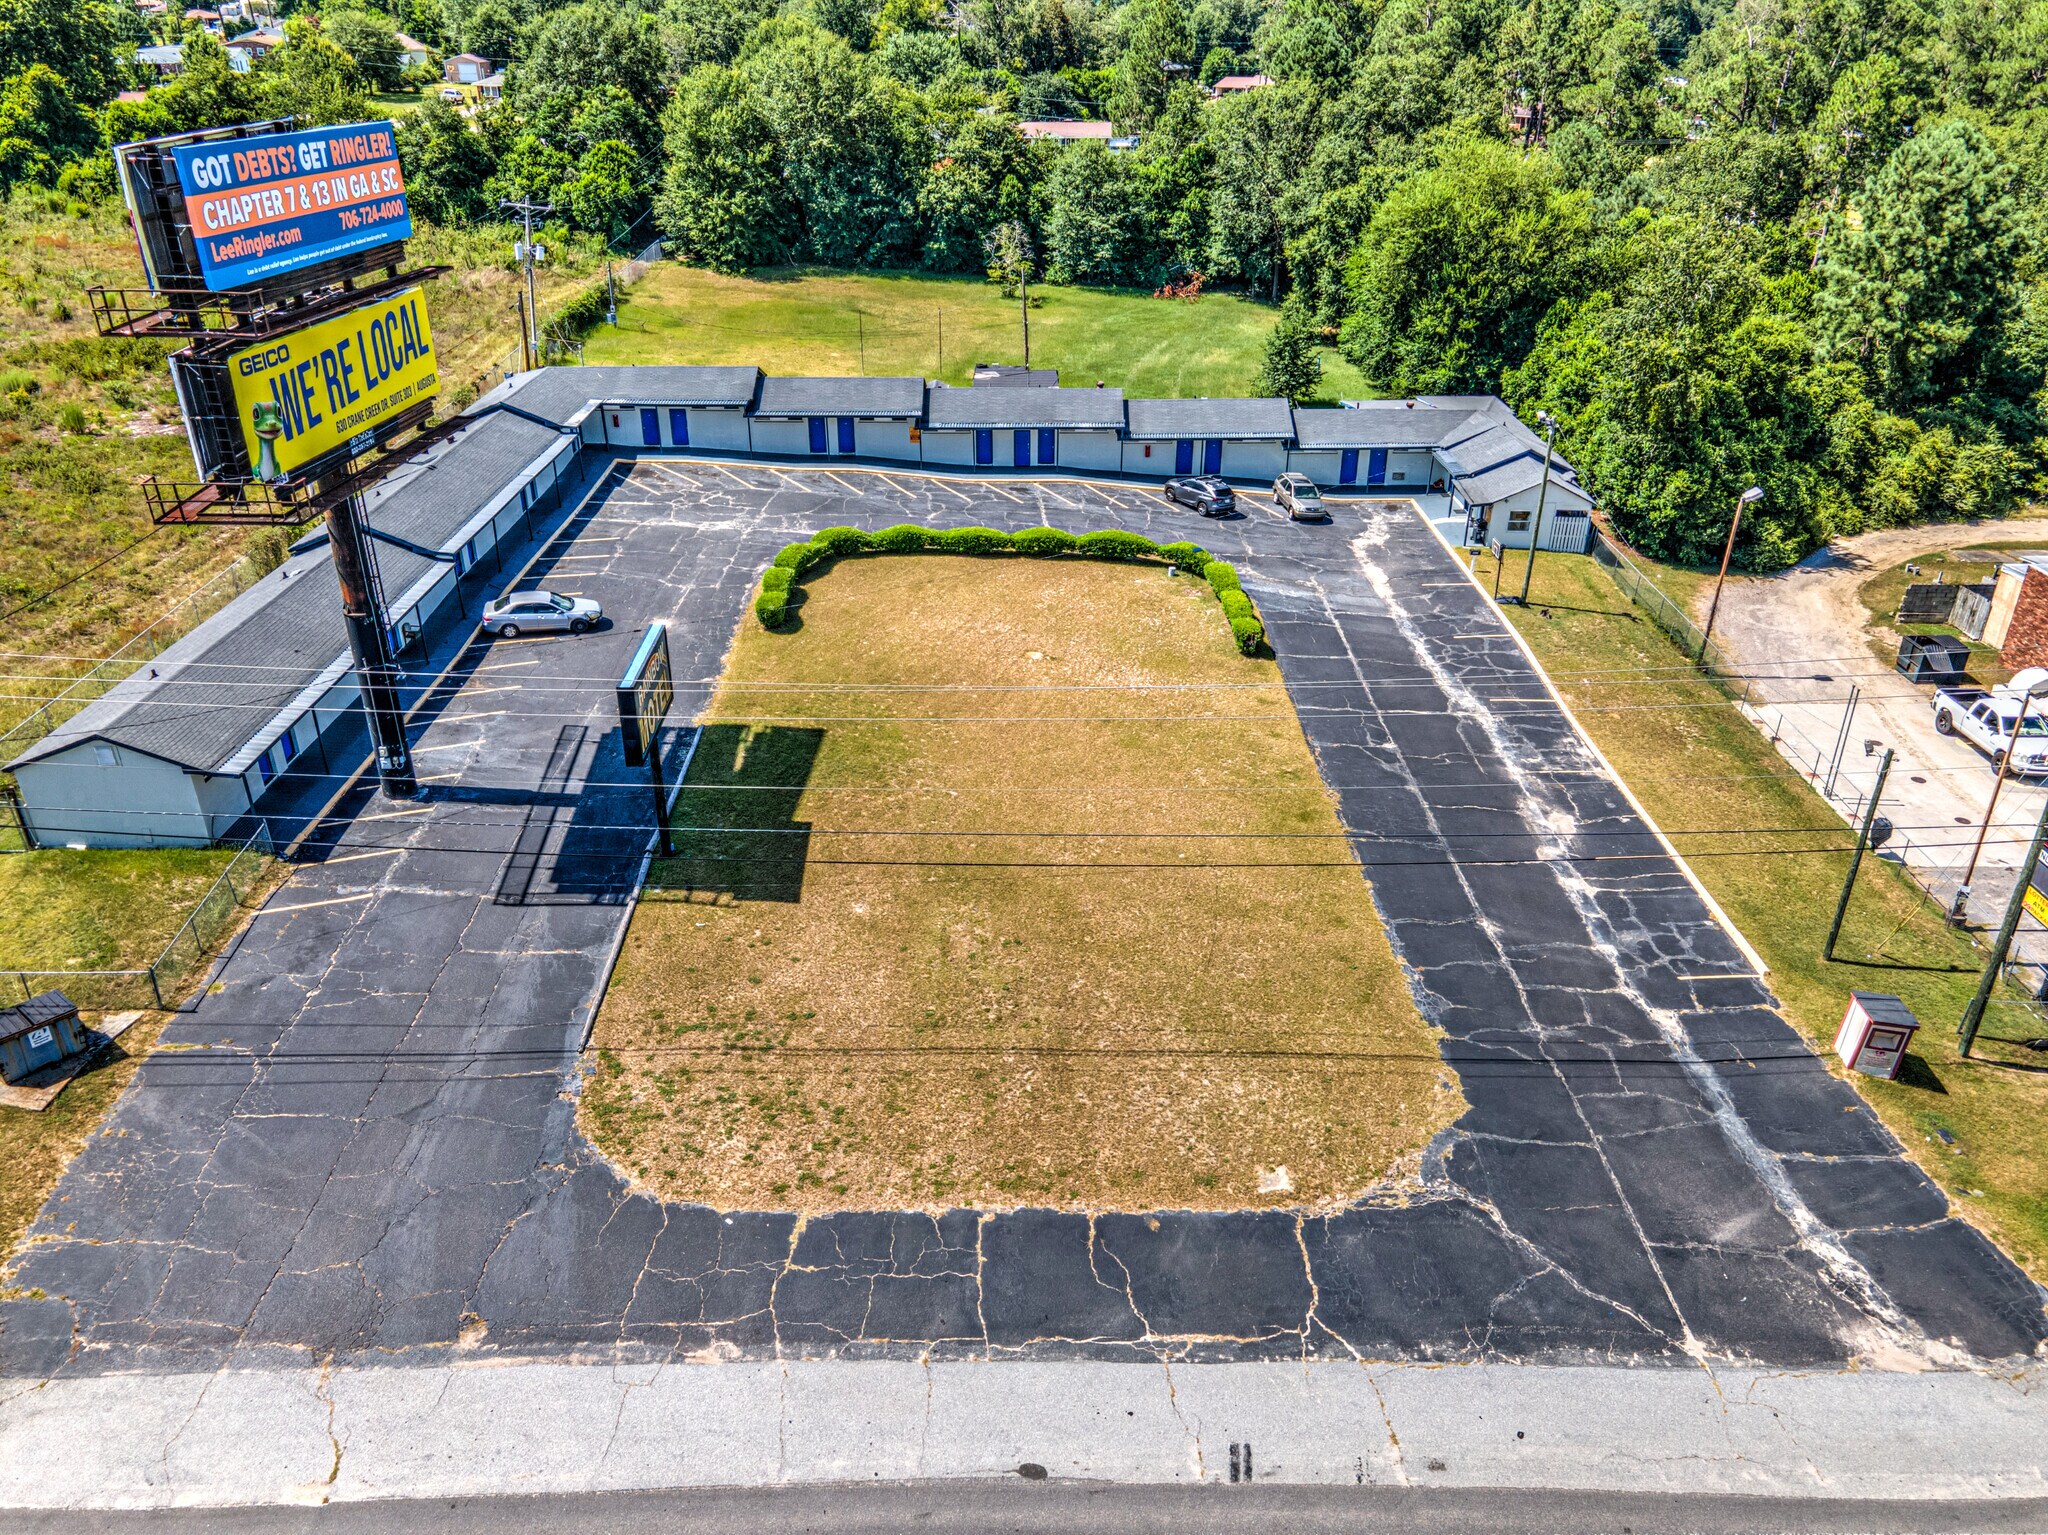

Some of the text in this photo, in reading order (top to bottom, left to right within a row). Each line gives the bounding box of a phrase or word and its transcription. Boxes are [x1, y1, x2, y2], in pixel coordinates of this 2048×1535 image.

[192, 132, 392, 189] GOT DEBTS? GET RINGLER!
[203, 167, 398, 230] CHAPTER 7 & 13 IN GA & SC
[339, 199, 403, 230] 706-724-4000
[210, 228, 302, 262] LeeRingler.com
[239, 344, 290, 377] GEICO
[269, 299, 429, 442] WE'RE LOCAL
[336, 419, 347, 433] 630
[347, 409, 365, 428] CRANE
[365, 402, 381, 420] CREEK
[390, 392, 403, 406] SUITE
[417, 373, 436, 391] AUGUSTA
[638, 642, 664, 708] RAINBOW
[638, 668, 671, 754] MOTEL
[2033, 901, 2045, 912] ATM
